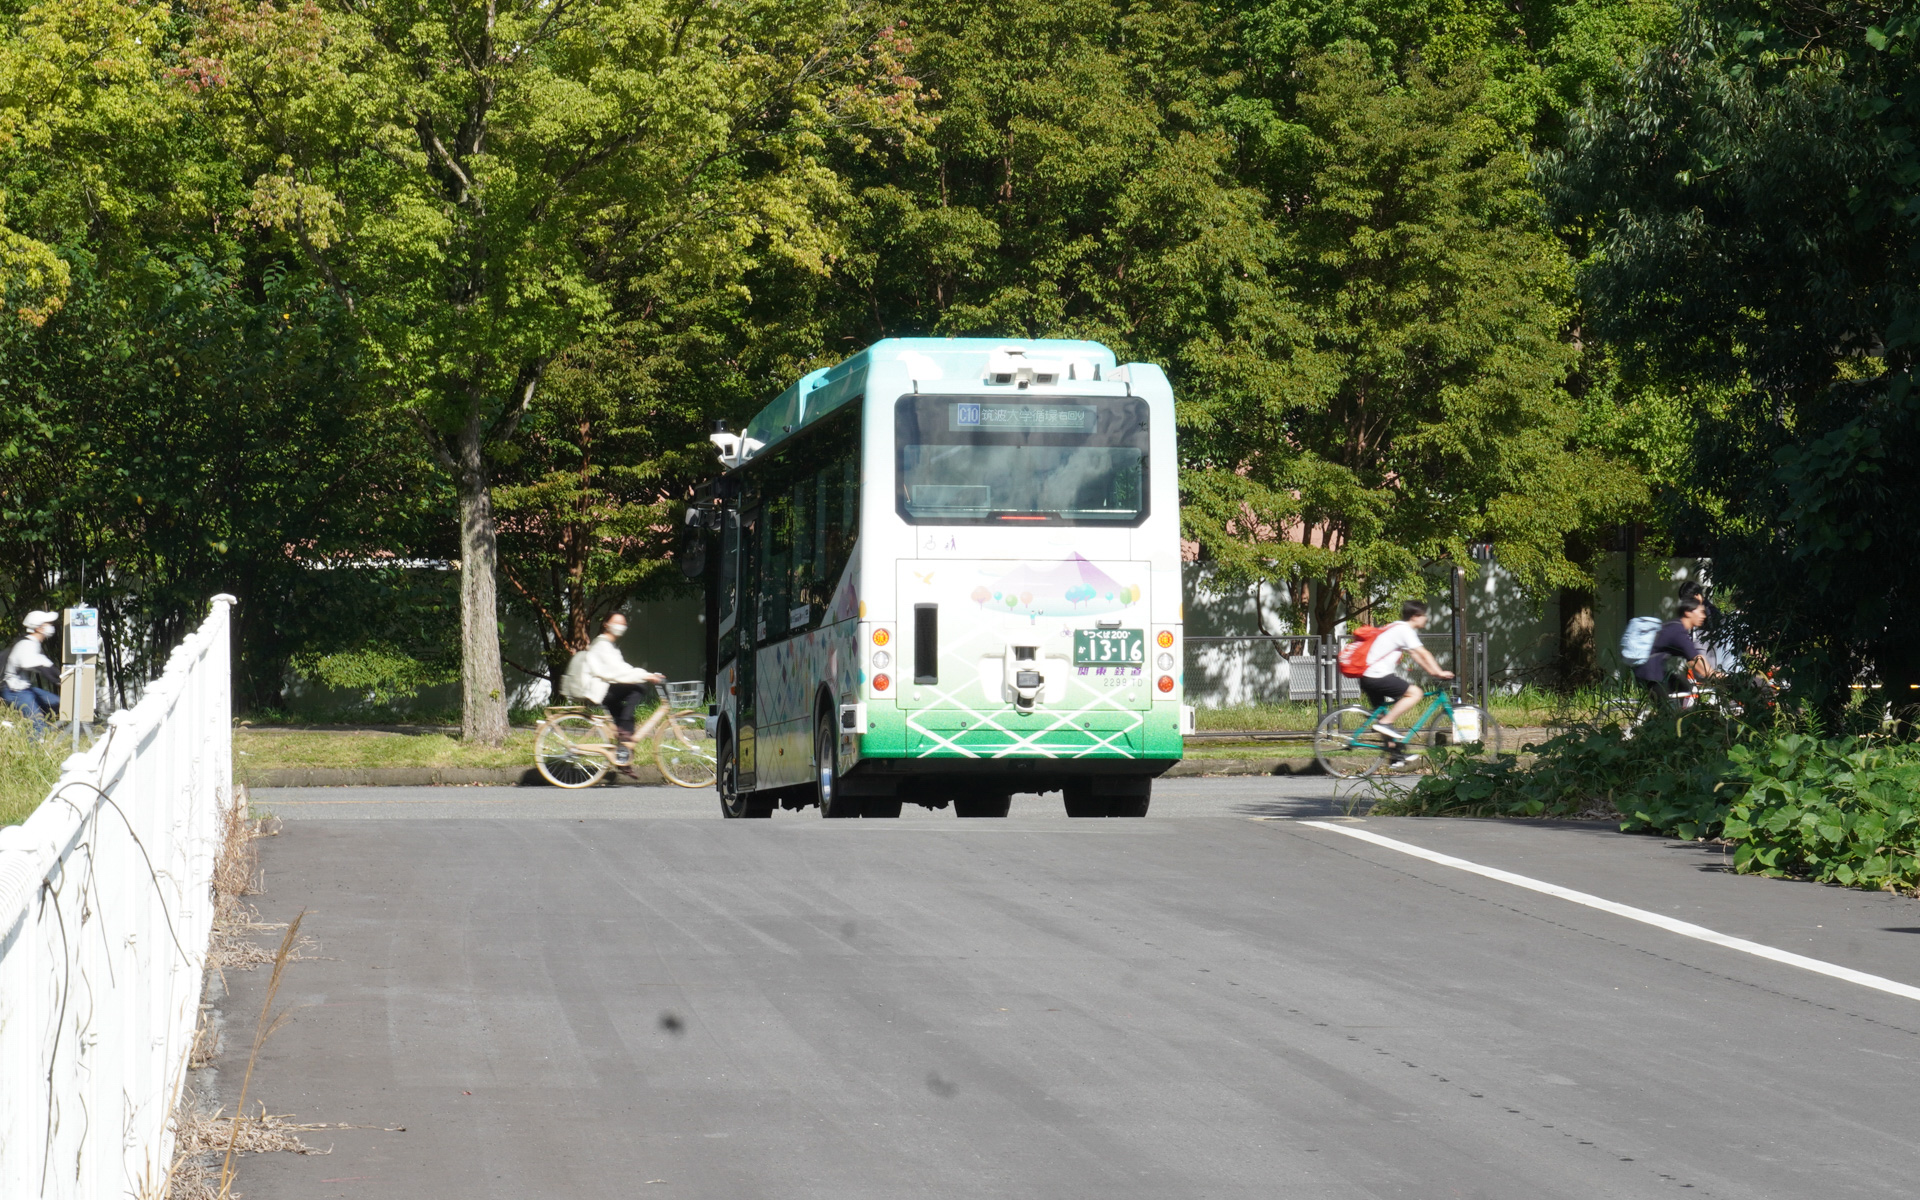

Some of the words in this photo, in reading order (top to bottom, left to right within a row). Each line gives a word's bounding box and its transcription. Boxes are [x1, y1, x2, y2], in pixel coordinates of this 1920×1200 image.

[959, 407, 979, 422] C10
[982, 409, 1084, 422] 筑波大学循環右回り
[1090, 639, 1142, 661] 13-16
